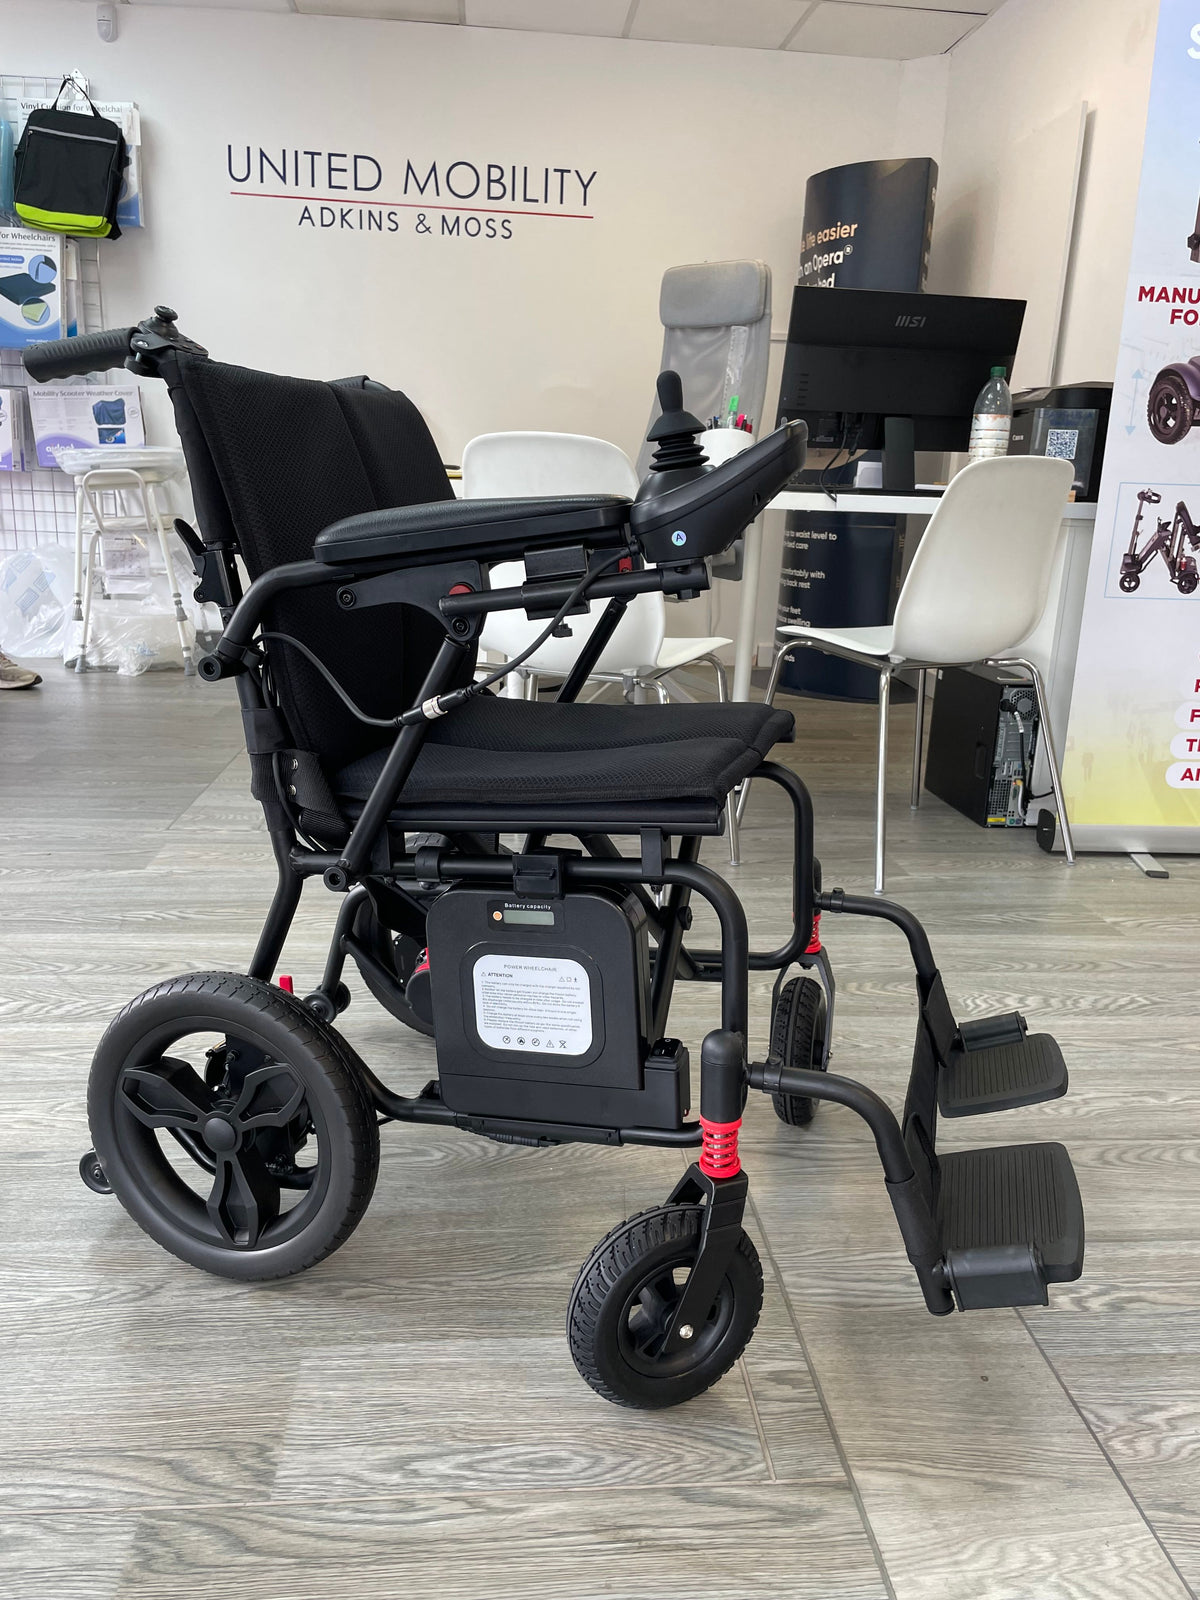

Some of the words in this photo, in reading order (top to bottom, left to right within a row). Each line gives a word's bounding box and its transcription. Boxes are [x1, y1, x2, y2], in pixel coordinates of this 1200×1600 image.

[20, 102, 39, 111] Vinyl
[41, 103, 71, 111] Cuion
[73, 104, 84, 112] for
[86, 104, 122, 113] Weelchai
[228, 144, 382, 191] UNITED
[404, 159, 597, 206] MOBILITY
[298, 205, 399, 232] ADKINS
[415, 213, 432, 234] &
[441, 215, 512, 239] MOSS
[11, 231, 56, 242] Wheelchairs
[817, 222, 858, 245] easier
[1170, 309, 1200, 326] FO
[33, 390, 59, 398] Mobility
[676, 533, 684, 542] A
[811, 531, 827, 540] level
[828, 532, 837, 541] to
[810, 570, 825, 579] with
[504, 902, 525, 910] Battery
[526, 903, 551, 911] capacity
